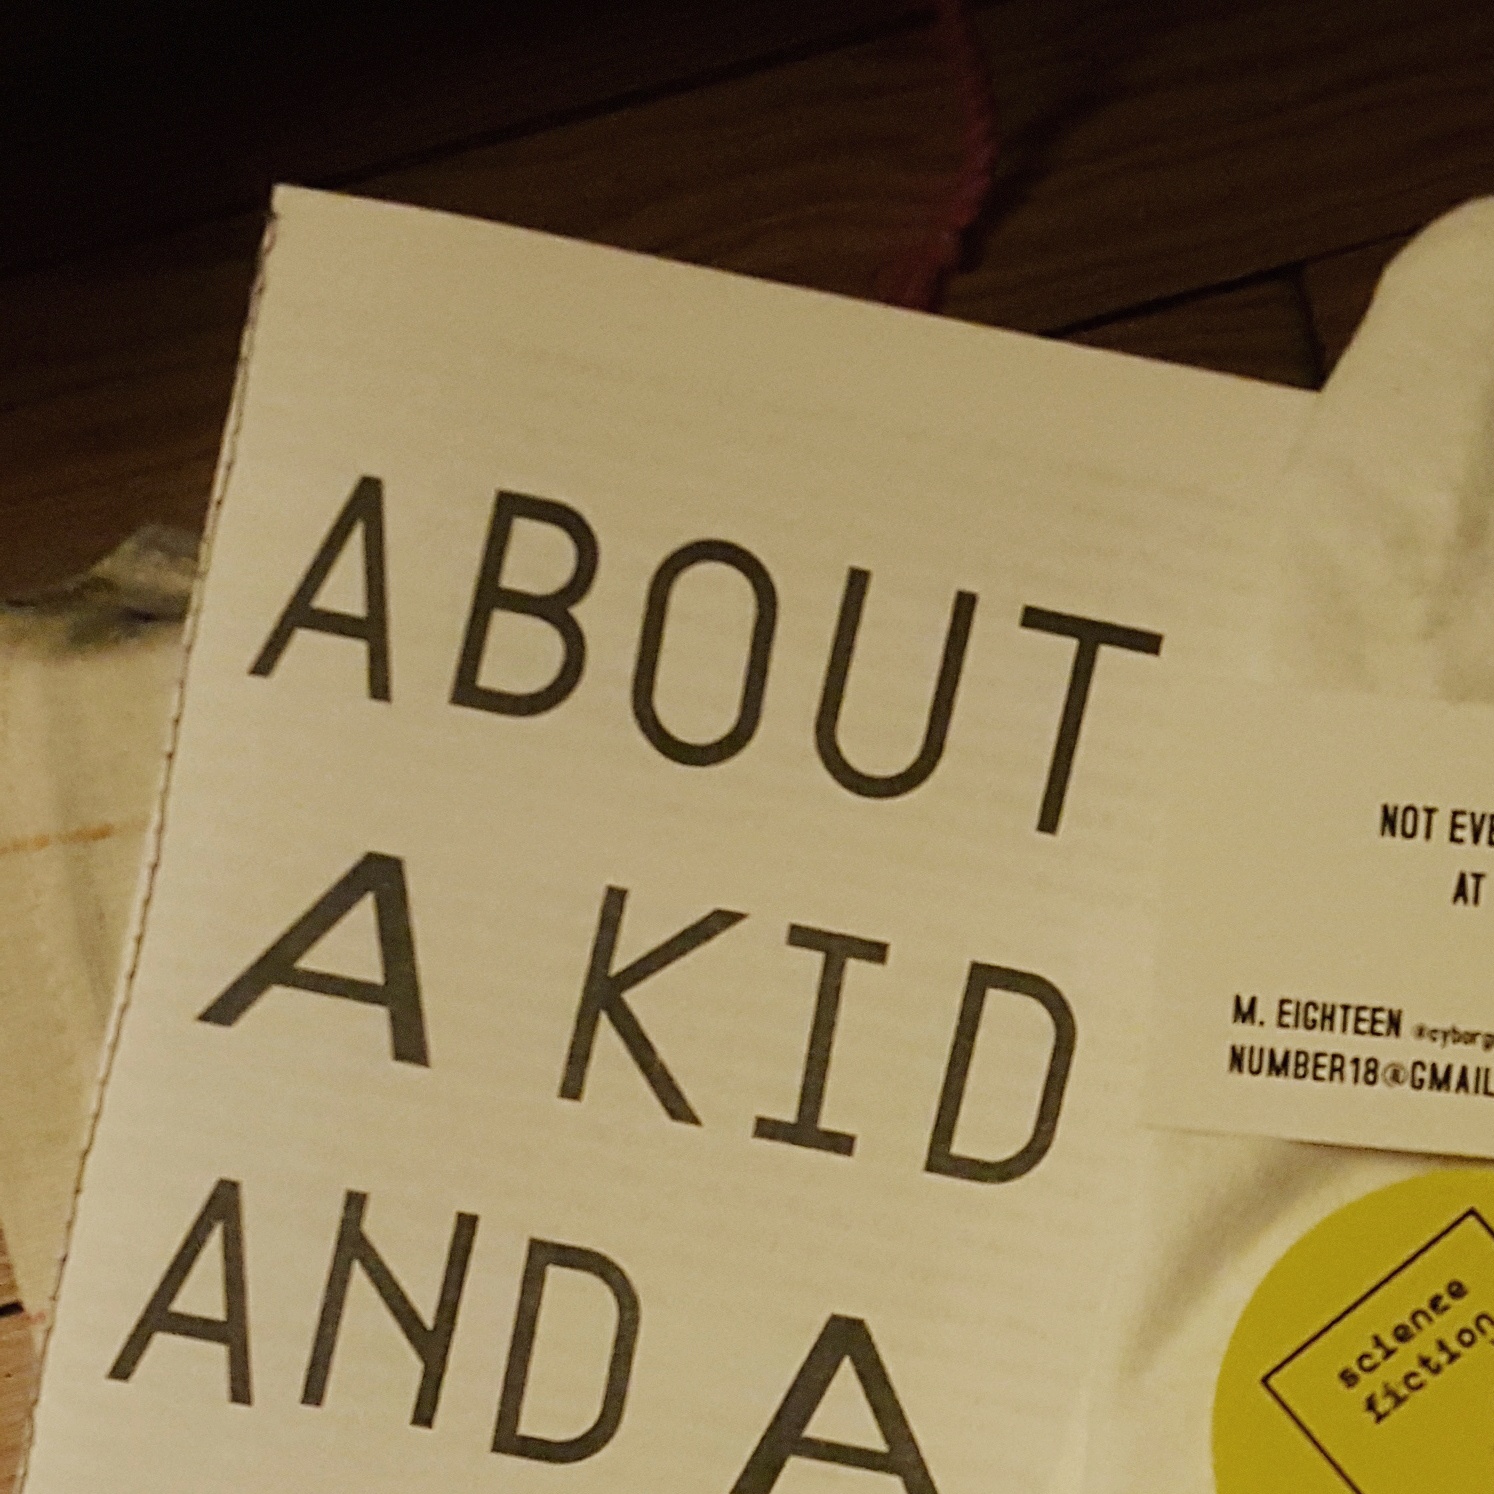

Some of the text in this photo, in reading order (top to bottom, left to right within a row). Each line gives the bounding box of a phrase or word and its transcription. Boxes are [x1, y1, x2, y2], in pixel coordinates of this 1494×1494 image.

[247, 474, 1165, 836] ABOUT
[1379, 802, 1440, 842] NOT
[1451, 870, 1487, 907] AT
[196, 850, 1078, 1185] A KID
[1232, 993, 1266, 1028] M.
[1275, 997, 1404, 1039] EIGHTEEN
[106, 1177, 642, 1466] AND
[1337, 1278, 1470, 1390] science
